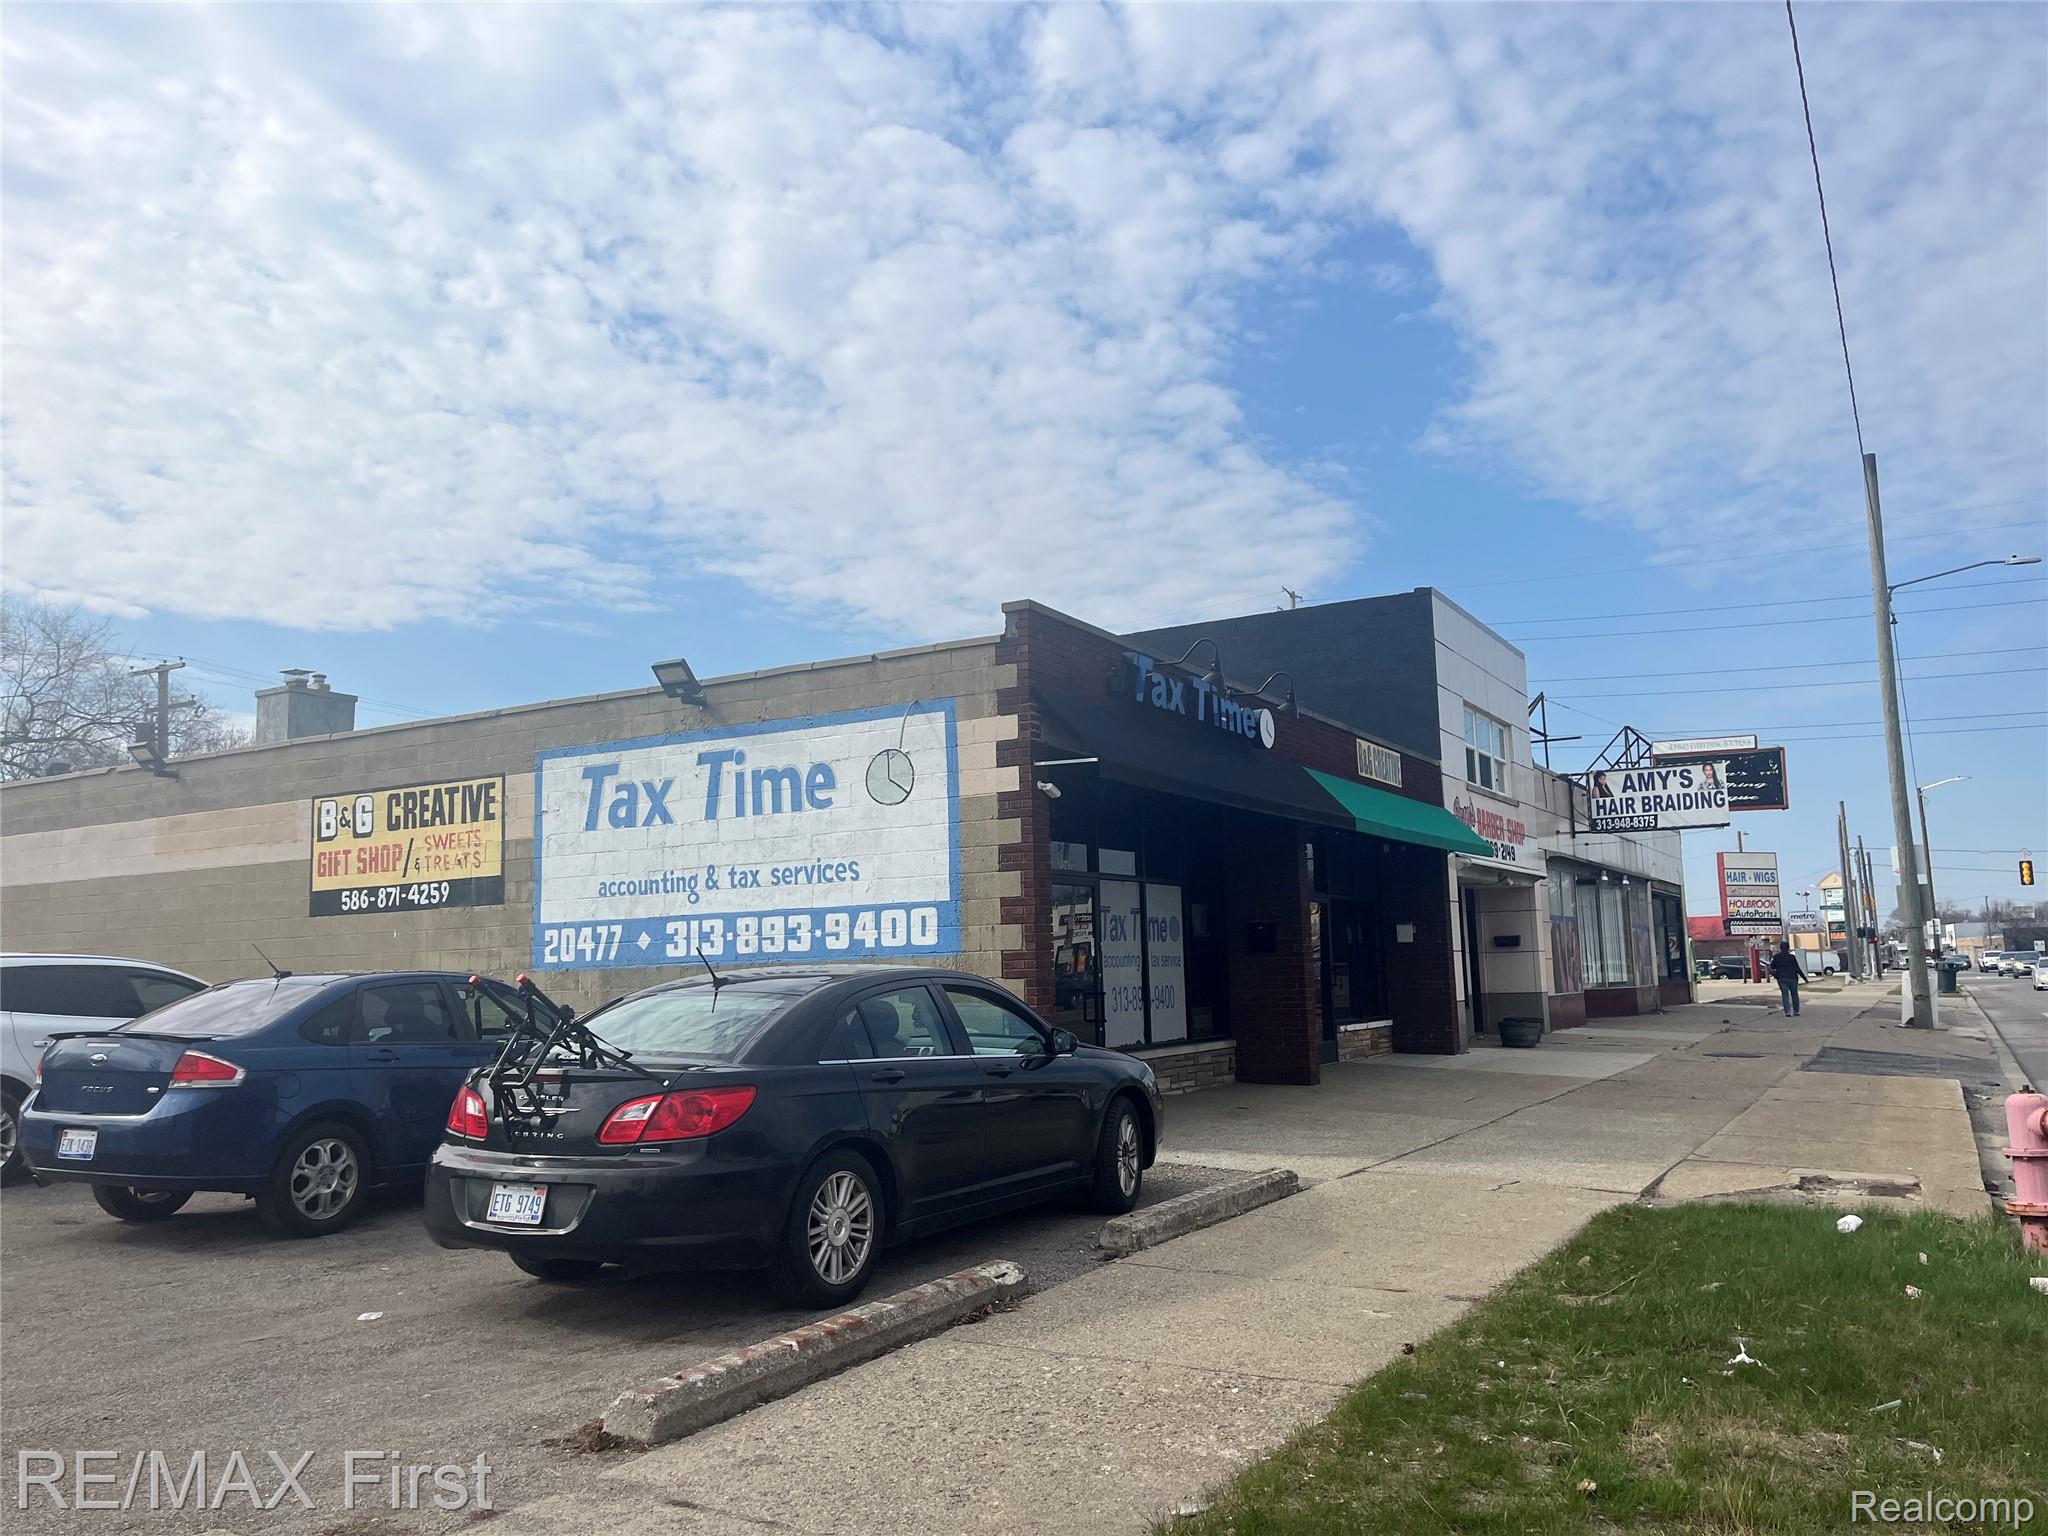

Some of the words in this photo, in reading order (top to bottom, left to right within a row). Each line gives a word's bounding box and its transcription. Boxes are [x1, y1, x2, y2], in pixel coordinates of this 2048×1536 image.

[1133, 652, 1186, 715] Tax
[1192, 677, 1256, 738] Time
[580, 763, 675, 831] Tax
[696, 749, 836, 820] Time
[1622, 769, 1693, 793] AMY'S
[317, 795, 374, 842] B&G
[387, 782, 496, 831] CREATIVE
[1596, 796, 1637, 816] HAIR
[1641, 790, 1726, 813] BRAIDING
[1477, 808, 1505, 841] BARBER
[1507, 818, 1525, 846] SHOP
[1596, 815, 1655, 831] 313-948-8375
[424, 829, 482, 851] SWEETS
[317, 849, 352, 877] GIFT
[424, 851, 481, 873] TREATS
[599, 871, 699, 905] accounting
[704, 865, 720, 891] &
[728, 863, 760, 889] tax
[770, 857, 860, 886] services
[1727, 872, 1747, 883] HAIR
[1754, 872, 1776, 883] WIGS
[341, 881, 450, 911] 586-871-4259
[1729, 900, 1776, 908] HOLBROOK
[1100, 905, 1127, 942] Tax
[1130, 907, 1168, 943] Tme
[1735, 910, 1773, 918] AutoParts
[1790, 912, 1815, 920] metro
[543, 925, 623, 964] 20477
[1103, 953, 1141, 972] accounting
[1112, 985, 1175, 1014] 313-89-9400
[493, 1193, 513, 1212] ETG
[516, 1195, 542, 1214] 9749
